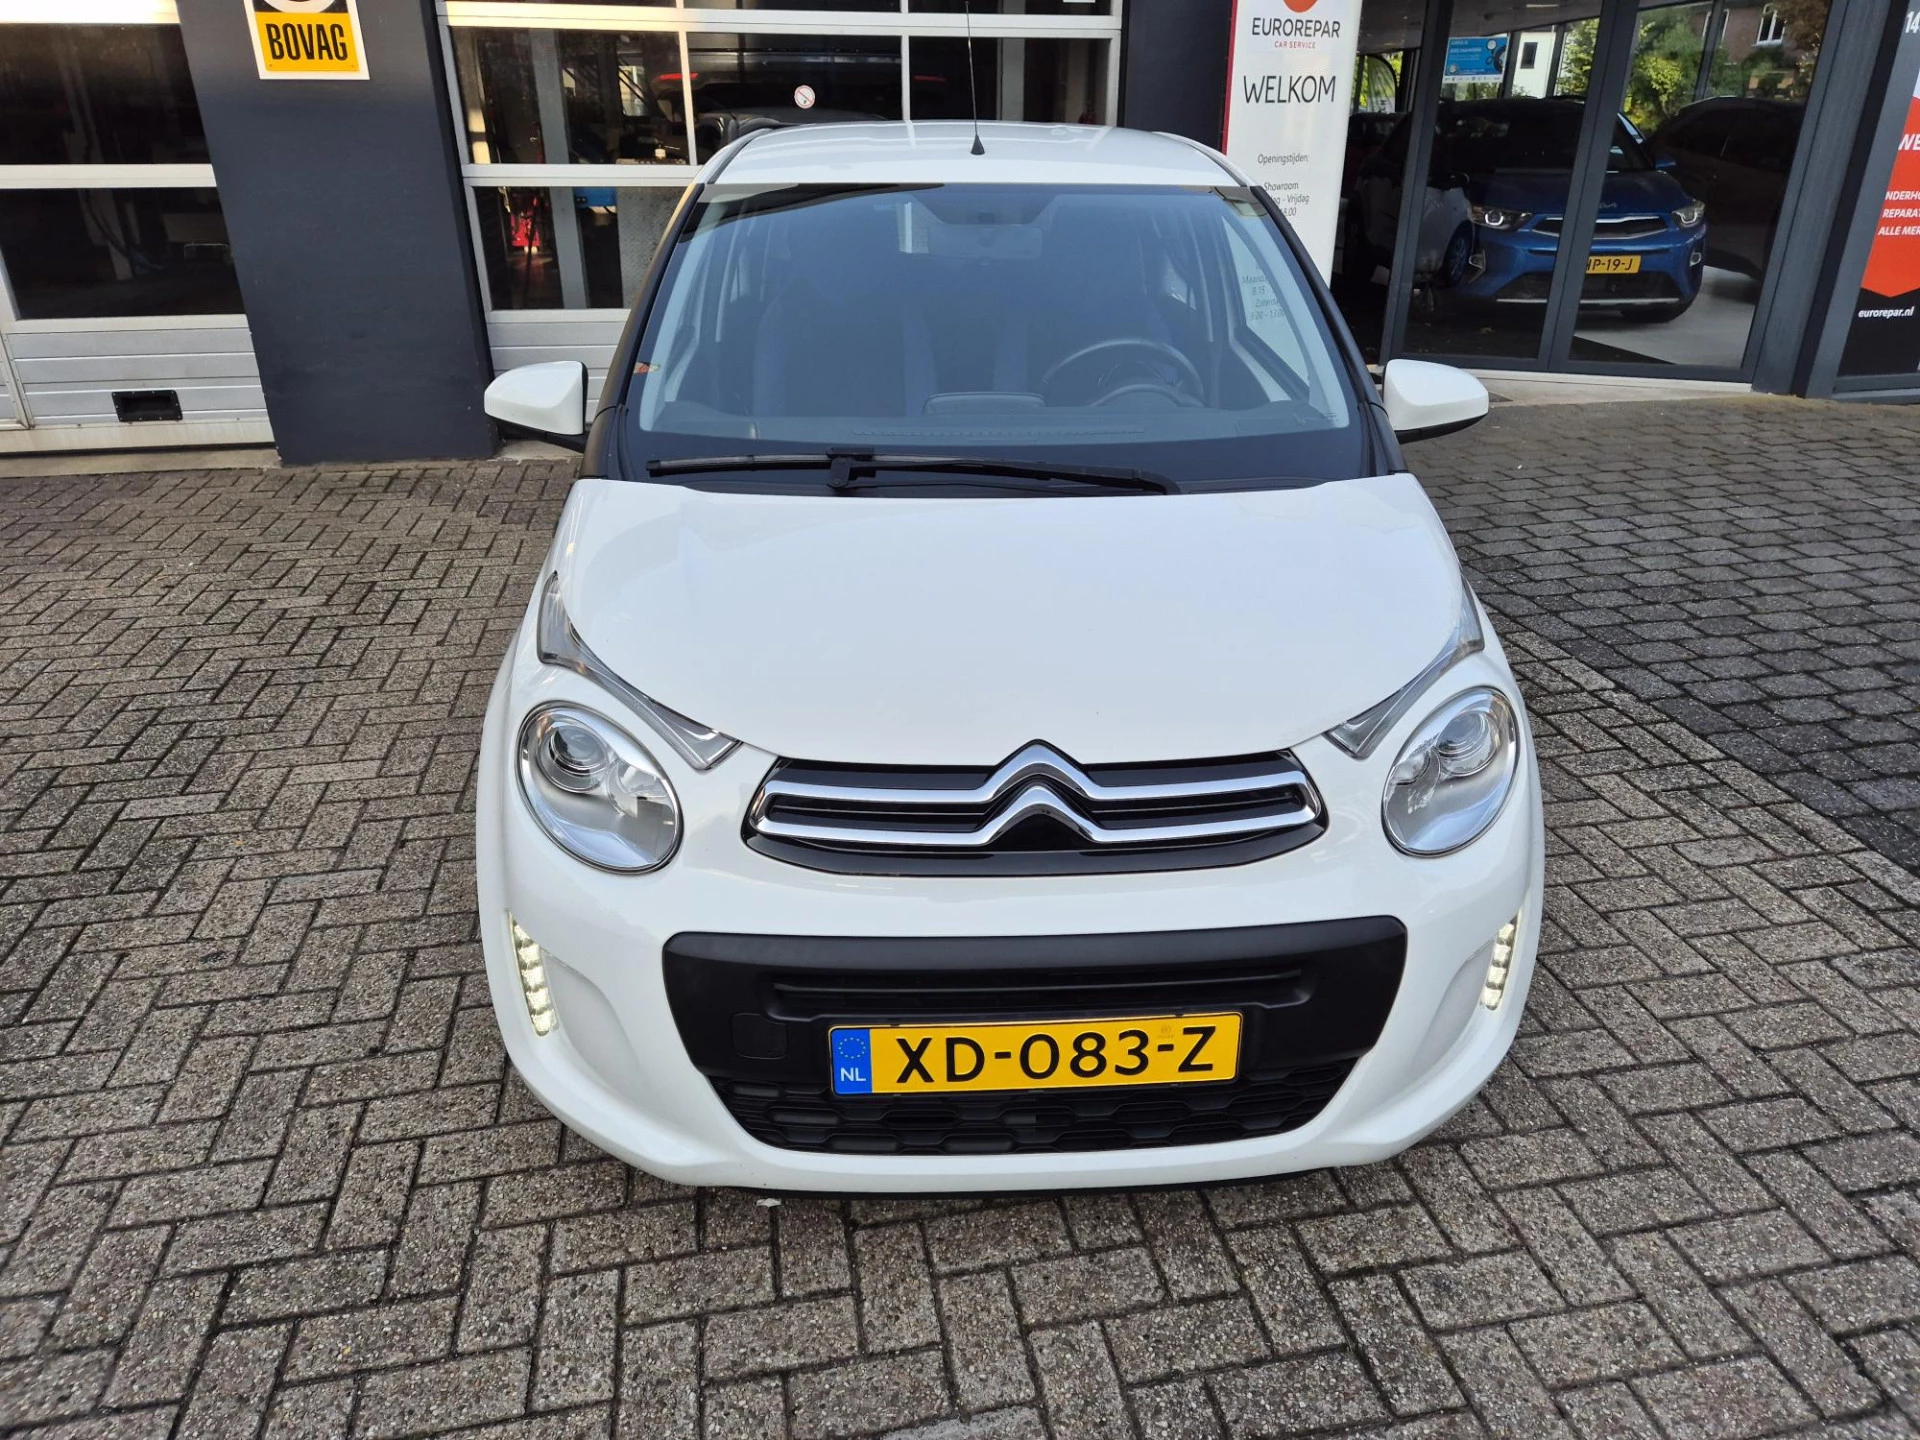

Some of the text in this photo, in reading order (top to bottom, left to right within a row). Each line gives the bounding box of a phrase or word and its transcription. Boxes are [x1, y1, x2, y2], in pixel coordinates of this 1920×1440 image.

[1252, 17, 1341, 38] EUROREPAR
[265, 23, 348, 61] BOVAG
[1289, 41, 1316, 49] SERVICE
[1243, 75, 1336, 104] WELKOM
[1263, 182, 1299, 191] Showroom
[1877, 226, 1902, 236] ALLE
[1858, 306, 1915, 319] eurorepar.nl
[895, 1025, 1217, 1084] XD-083-Z
[840, 1067, 867, 1083] NL
